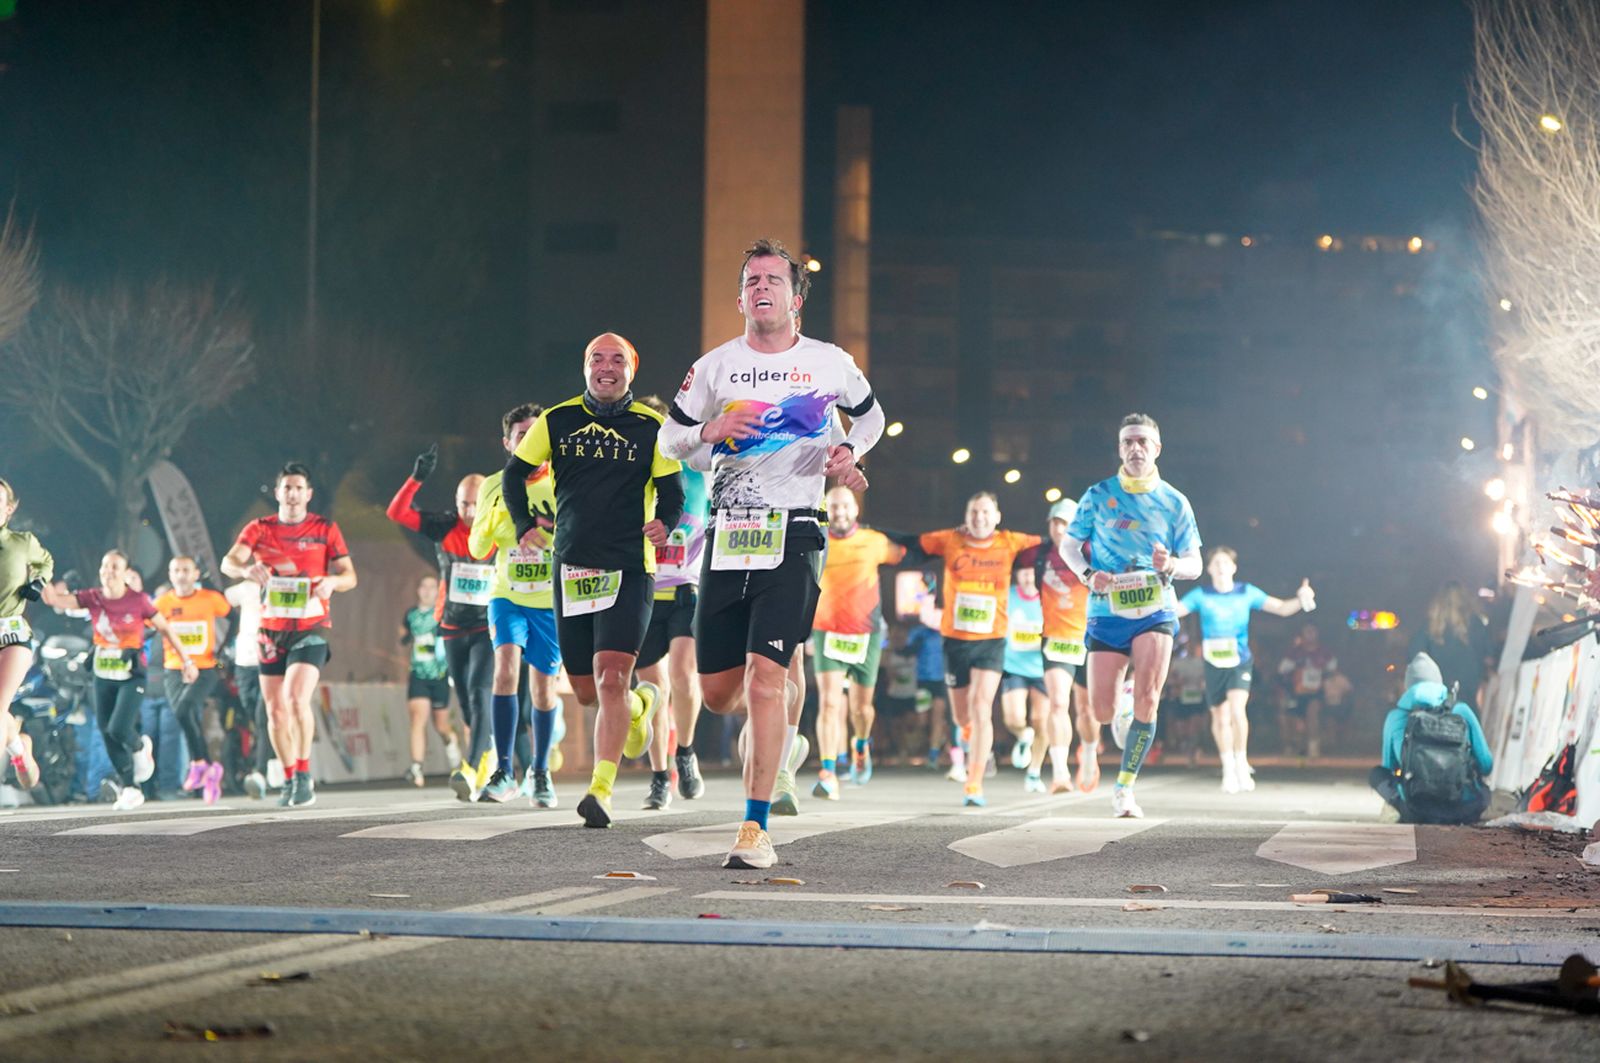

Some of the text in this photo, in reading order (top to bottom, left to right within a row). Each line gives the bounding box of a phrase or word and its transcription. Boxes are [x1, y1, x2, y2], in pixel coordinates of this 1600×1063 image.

[730, 366, 812, 388] calderón
[559, 437, 638, 449] ALPARGATA
[559, 444, 636, 461] TRAIL
[728, 530, 773, 549] 8404
[516, 564, 547, 578] 9574
[457, 578, 488, 591] 12687
[575, 575, 610, 596] 1622
[1120, 587, 1154, 605] 9002
